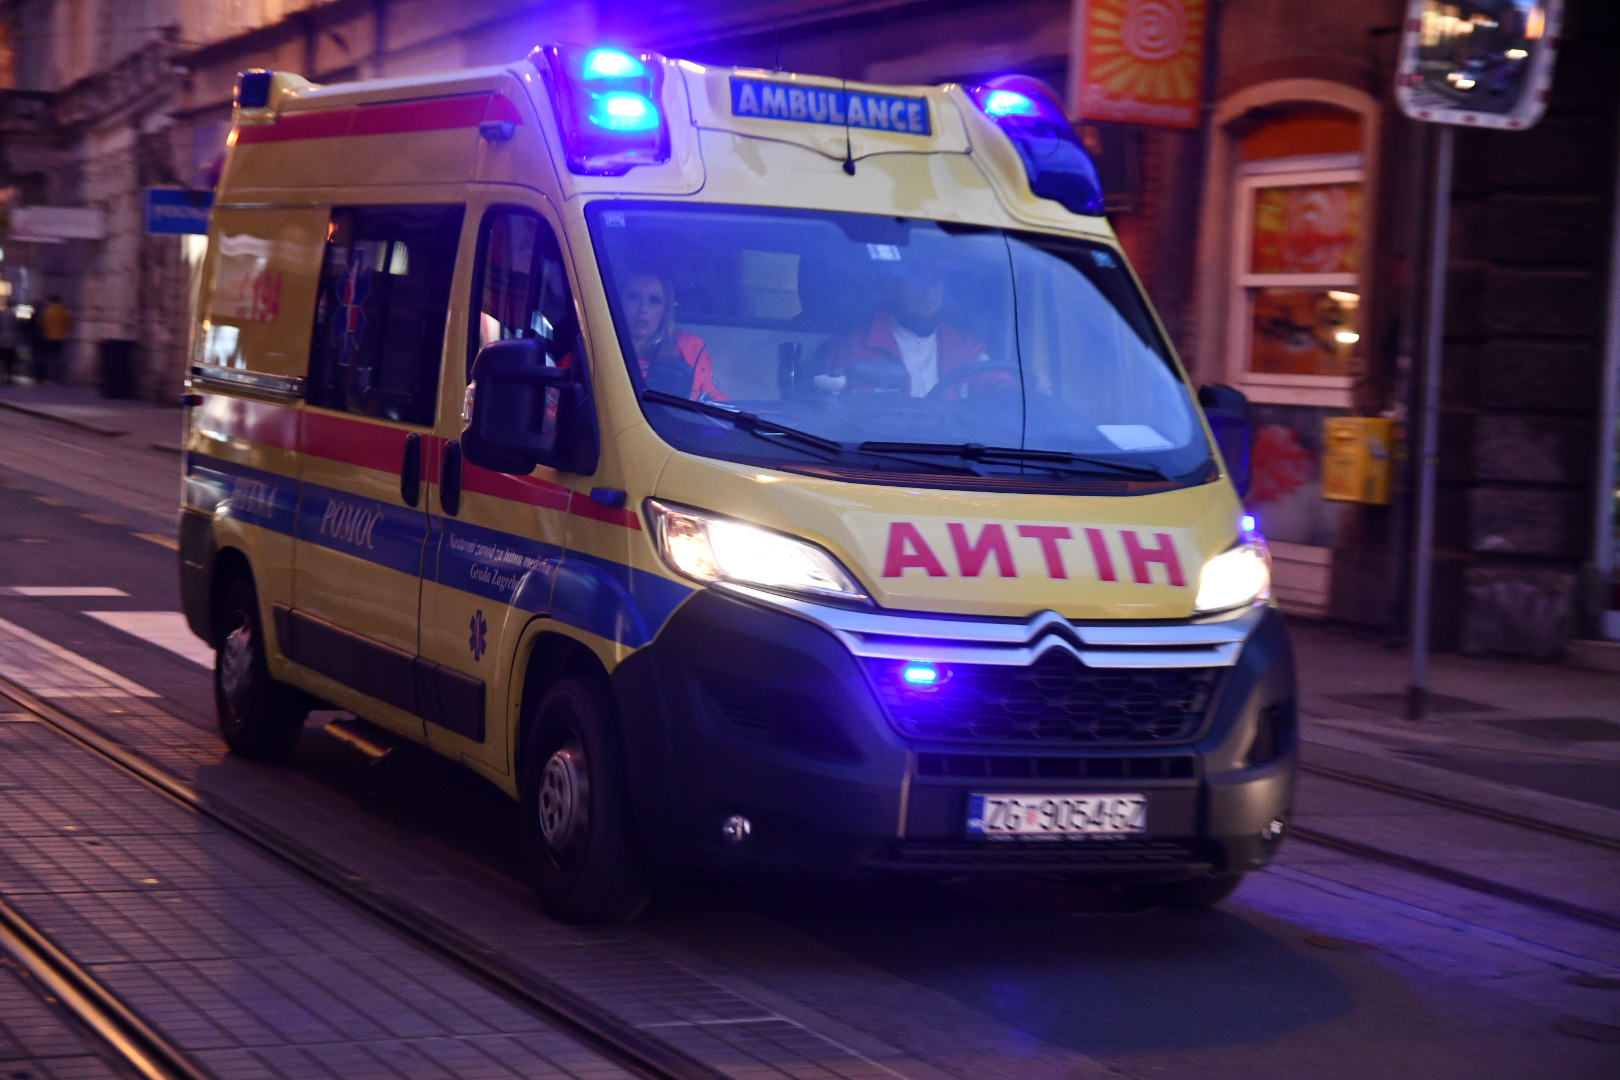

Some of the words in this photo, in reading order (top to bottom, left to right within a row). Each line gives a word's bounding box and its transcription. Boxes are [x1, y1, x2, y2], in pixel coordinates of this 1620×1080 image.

[738, 82, 924, 132] AMBULANCE
[320, 498, 384, 550] POMOĆ
[470, 563, 491, 583] Grada
